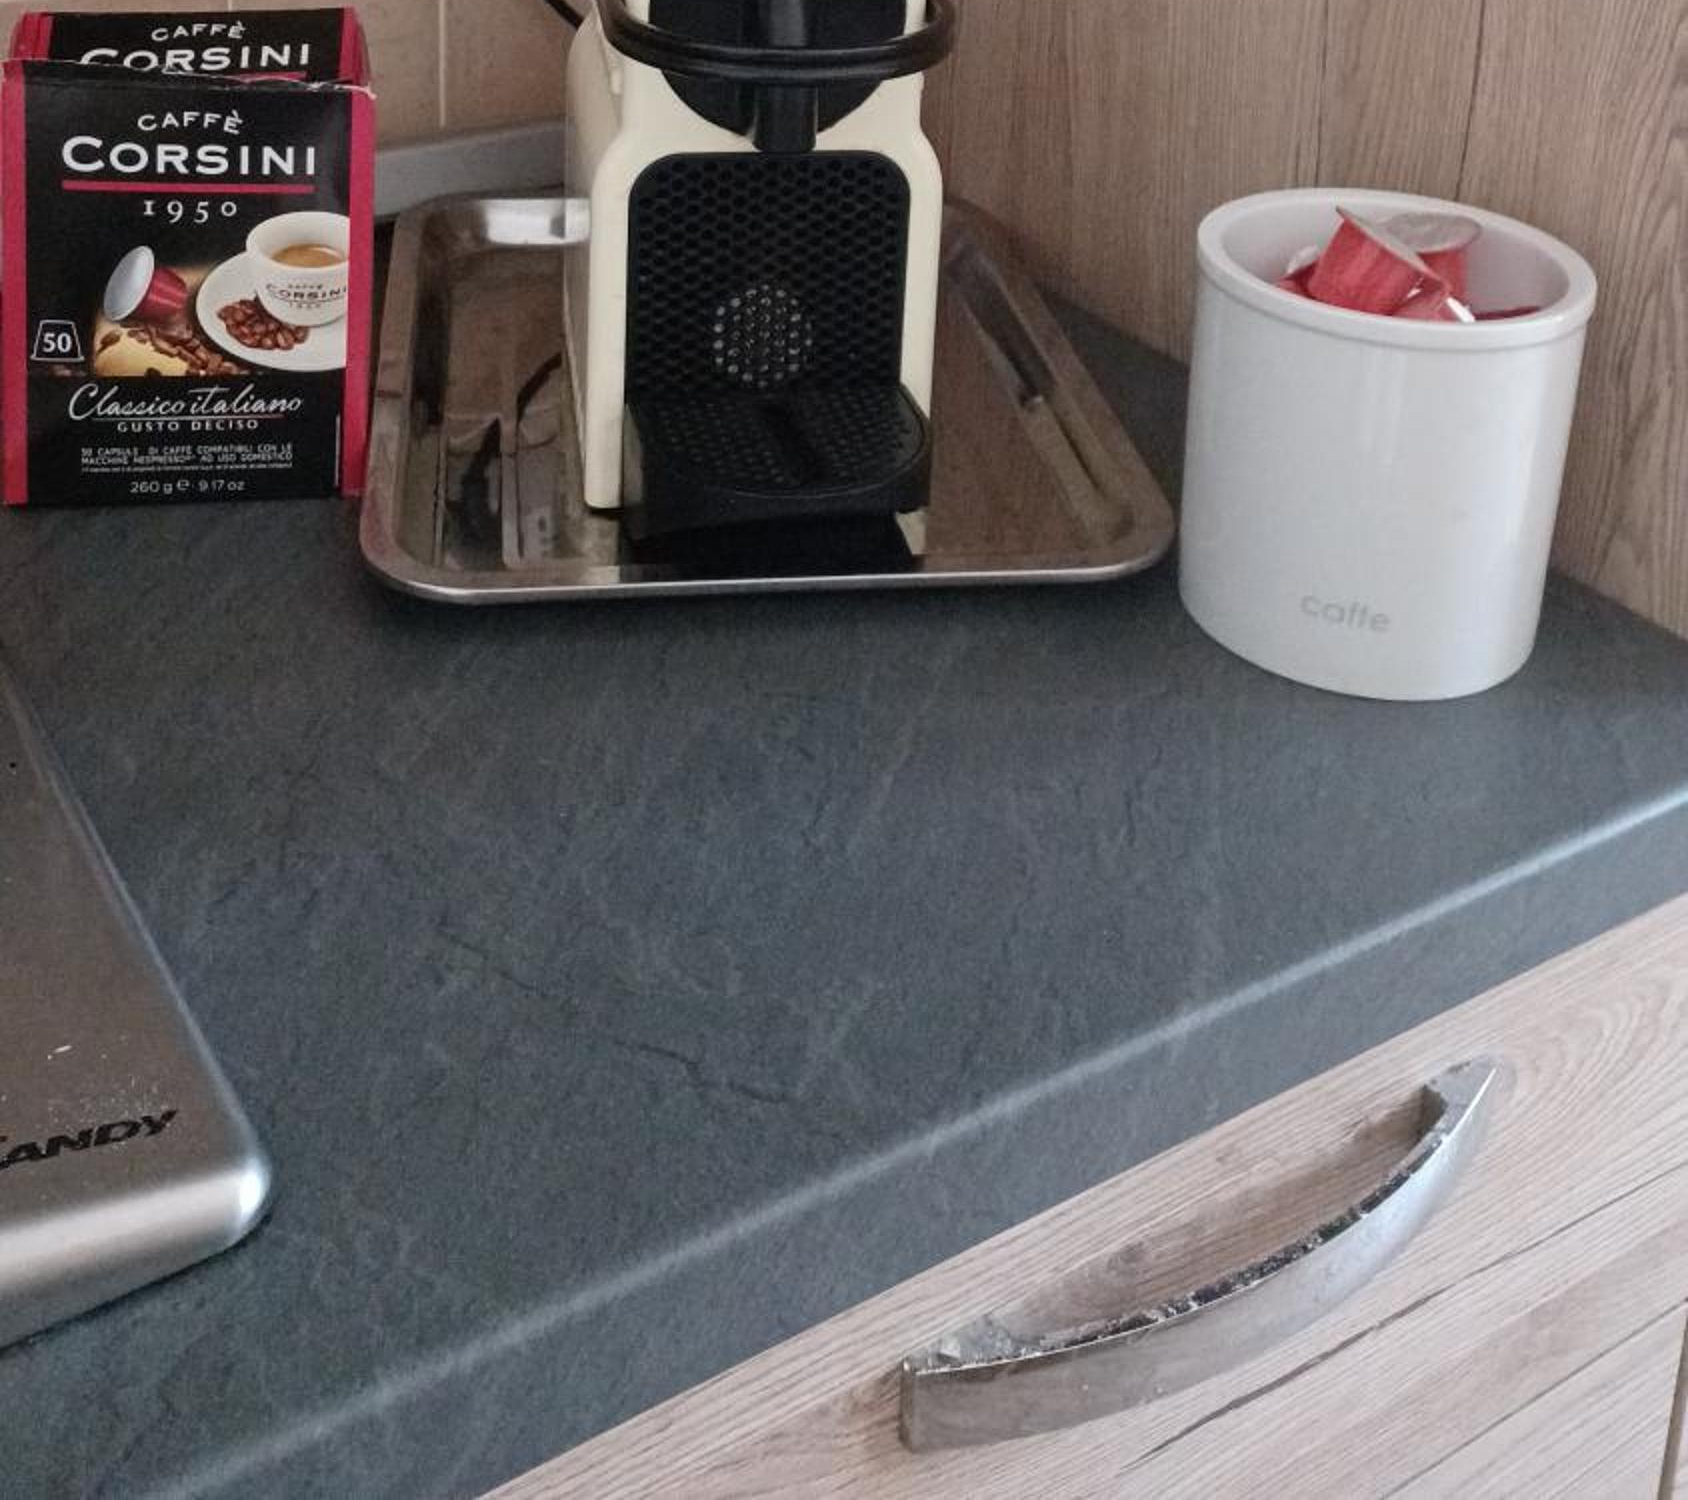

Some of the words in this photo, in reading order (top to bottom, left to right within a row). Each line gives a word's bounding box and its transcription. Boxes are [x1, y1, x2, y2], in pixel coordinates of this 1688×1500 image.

[151, 20, 246, 41] CAFFÈ
[137, 110, 243, 135] CAFFÈ
[61, 135, 315, 175] CORSINI
[143, 200, 237, 223] 1950
[43, 333, 72, 353] 50
[68, 382, 185, 420] Classico
[188, 383, 302, 415] italiano
[117, 421, 180, 433] GUSTO
[191, 419, 259, 431] DECISO
[129, 481, 160, 493] 260
[163, 483, 173, 495] g
[227, 481, 245, 491] oz
[0, 1109, 179, 1169] ANDY
